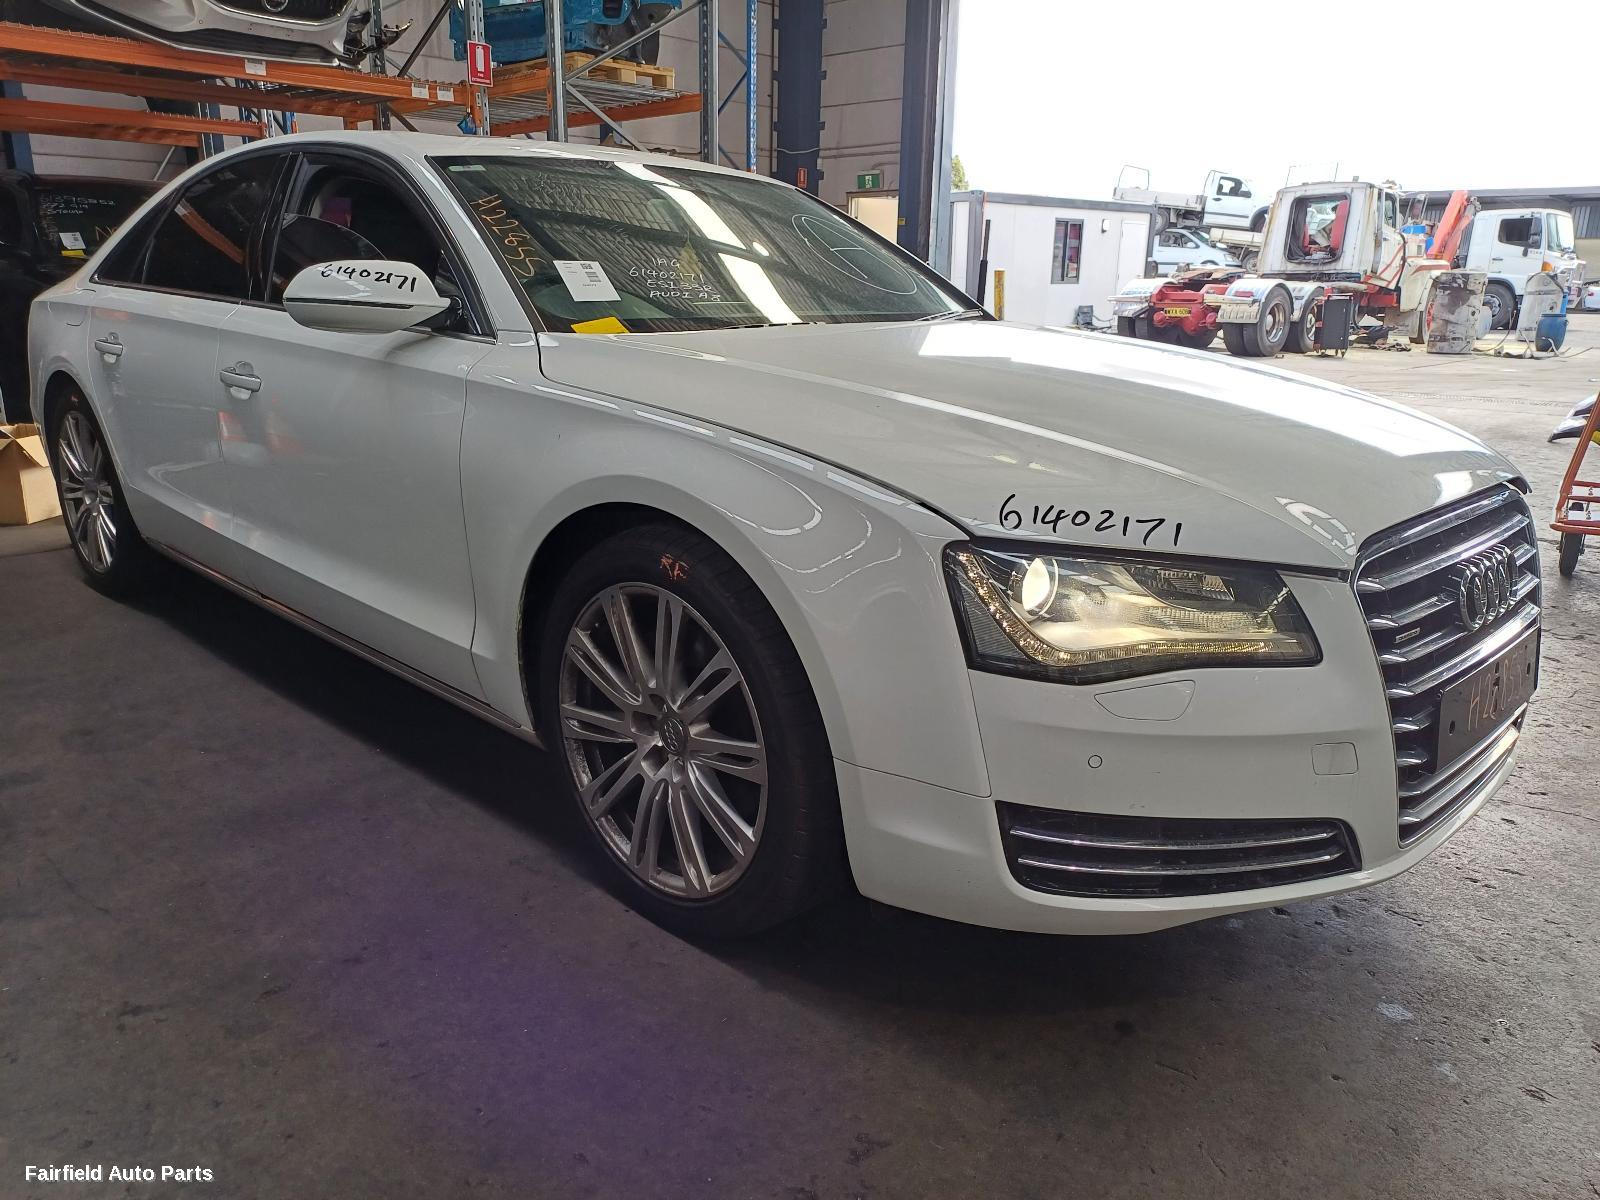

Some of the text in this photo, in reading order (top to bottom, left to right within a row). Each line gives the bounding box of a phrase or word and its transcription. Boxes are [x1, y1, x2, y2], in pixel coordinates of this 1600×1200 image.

[321, 263, 417, 292] 61402171
[629, 266, 705, 284] 61402171
[649, 290, 694, 299] AUDI
[999, 493, 1183, 547] 61402171
